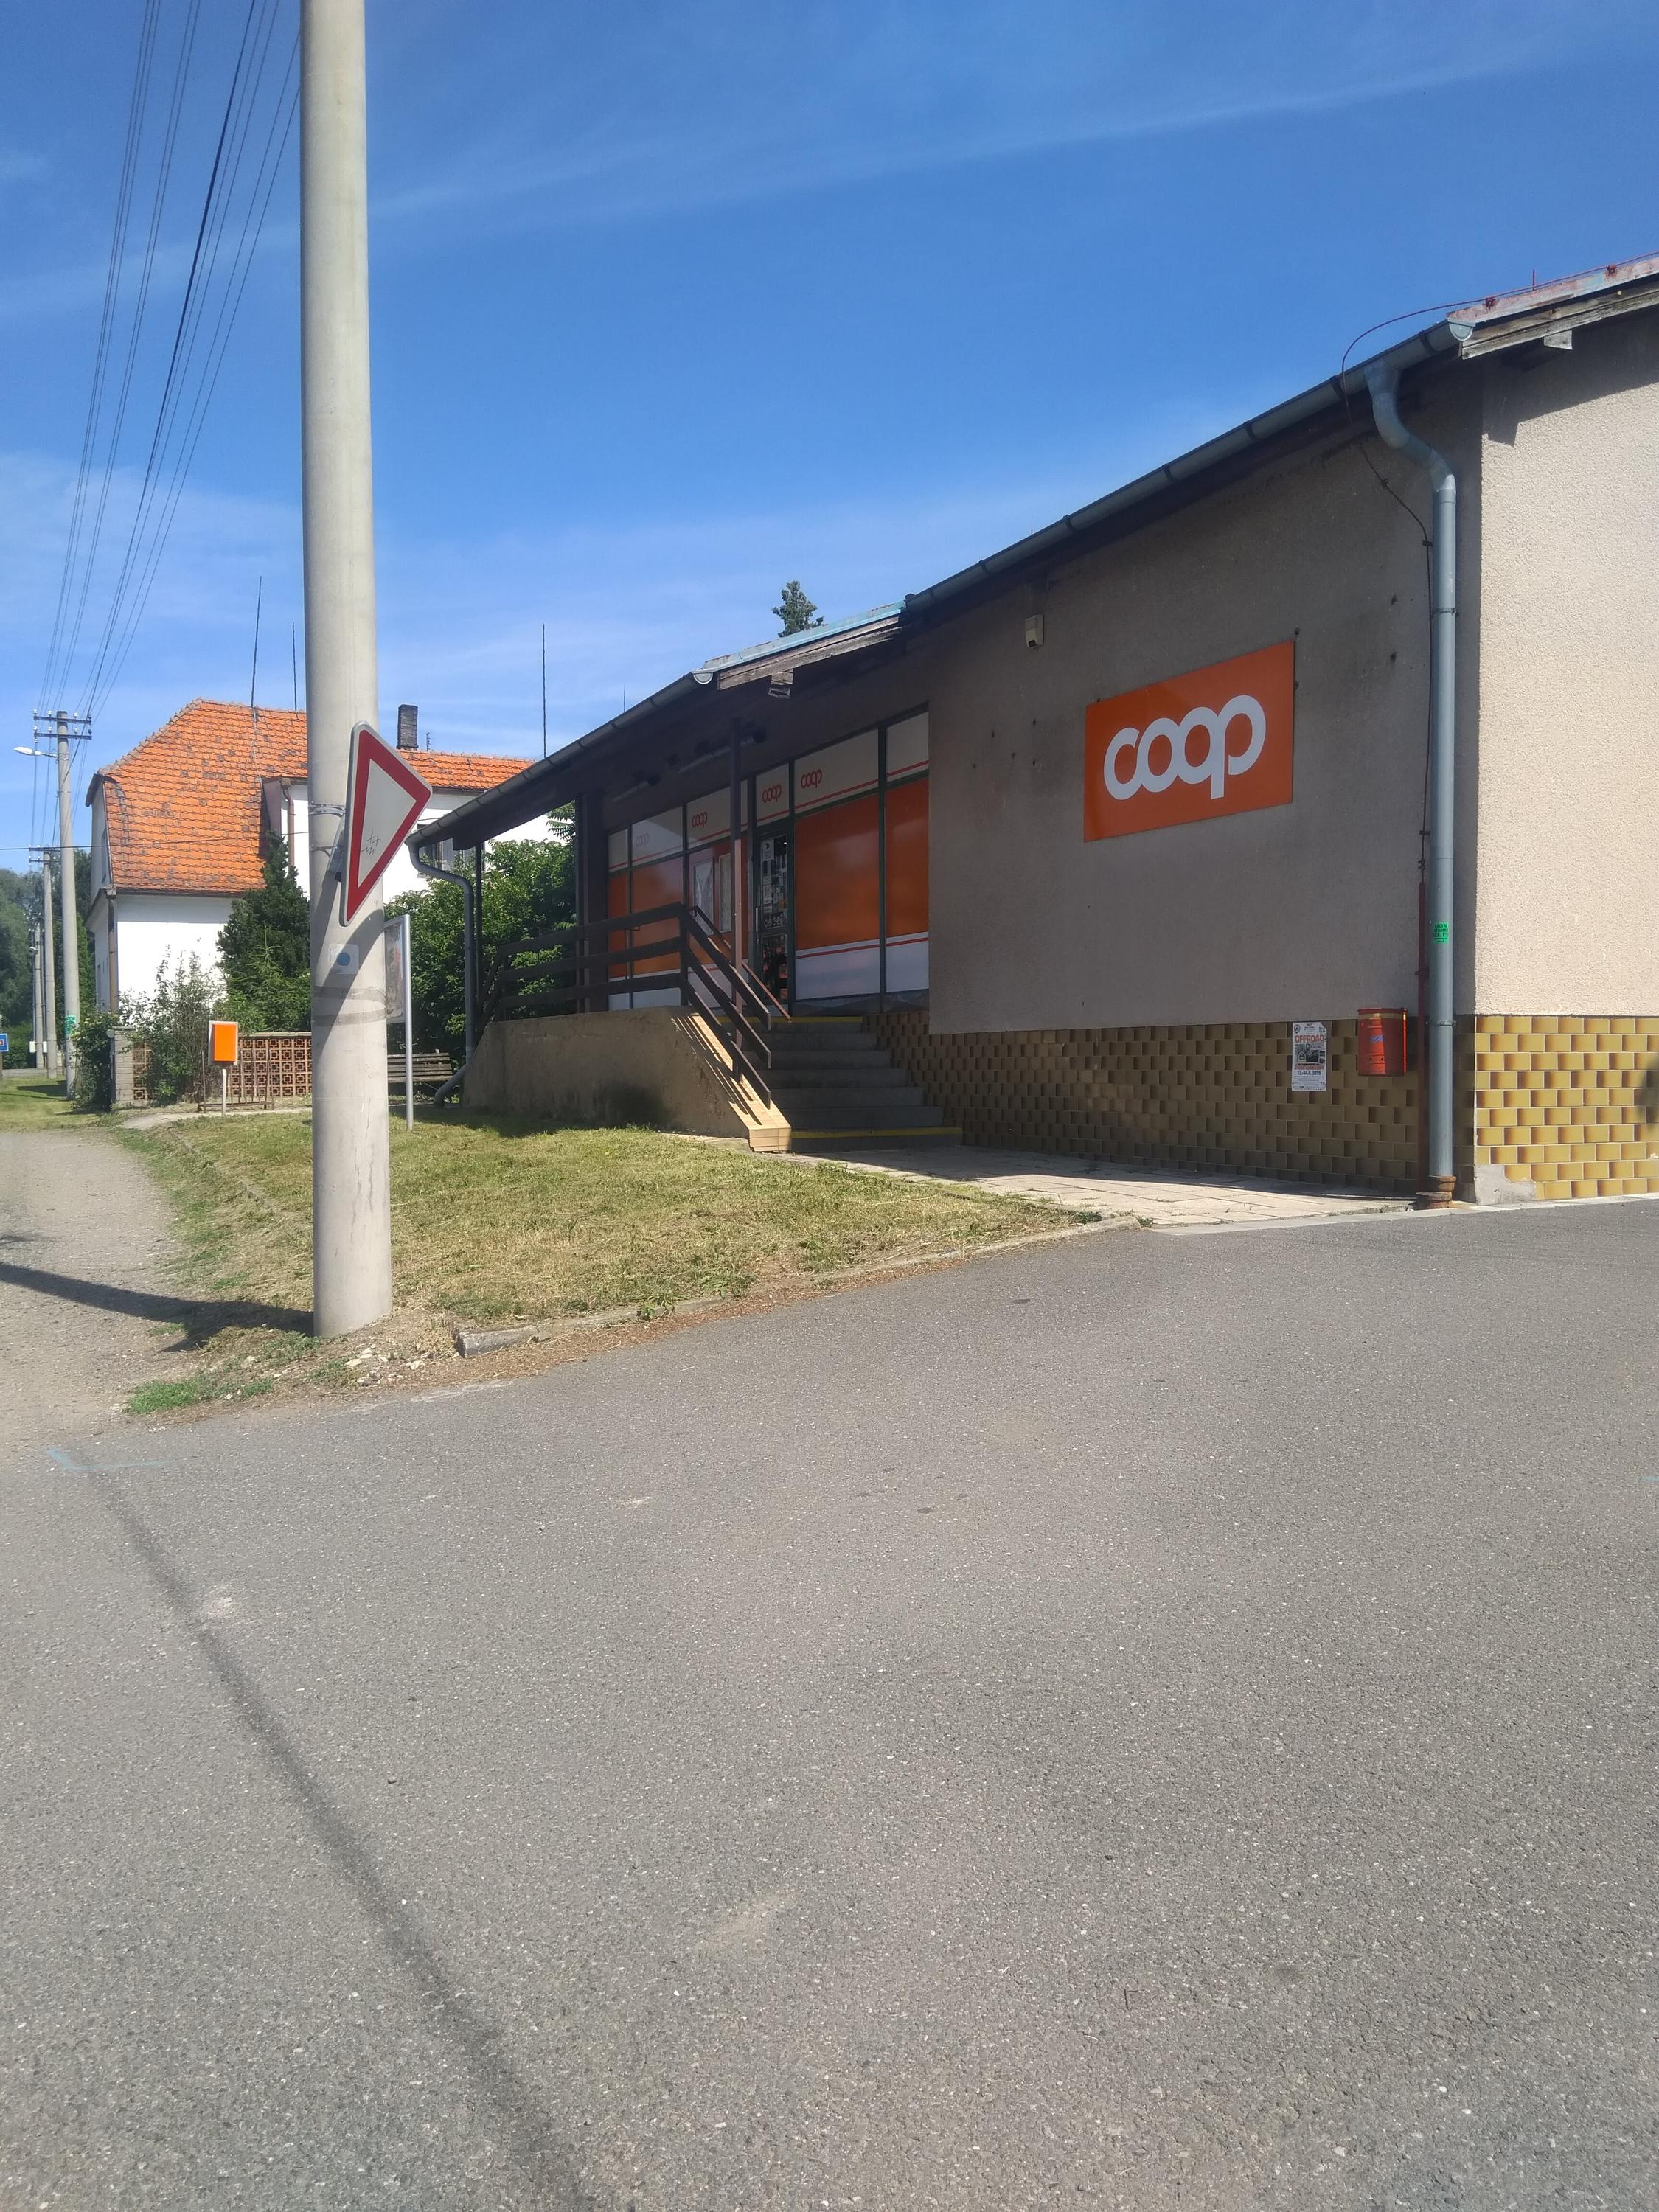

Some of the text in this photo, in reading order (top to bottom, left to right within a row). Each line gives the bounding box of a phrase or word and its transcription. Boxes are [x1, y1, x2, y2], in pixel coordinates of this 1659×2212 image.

[1104, 695, 1266, 801] coop
[801, 768, 822, 789] coop
[762, 784, 782, 804] coop
[692, 811, 708, 828] coop
